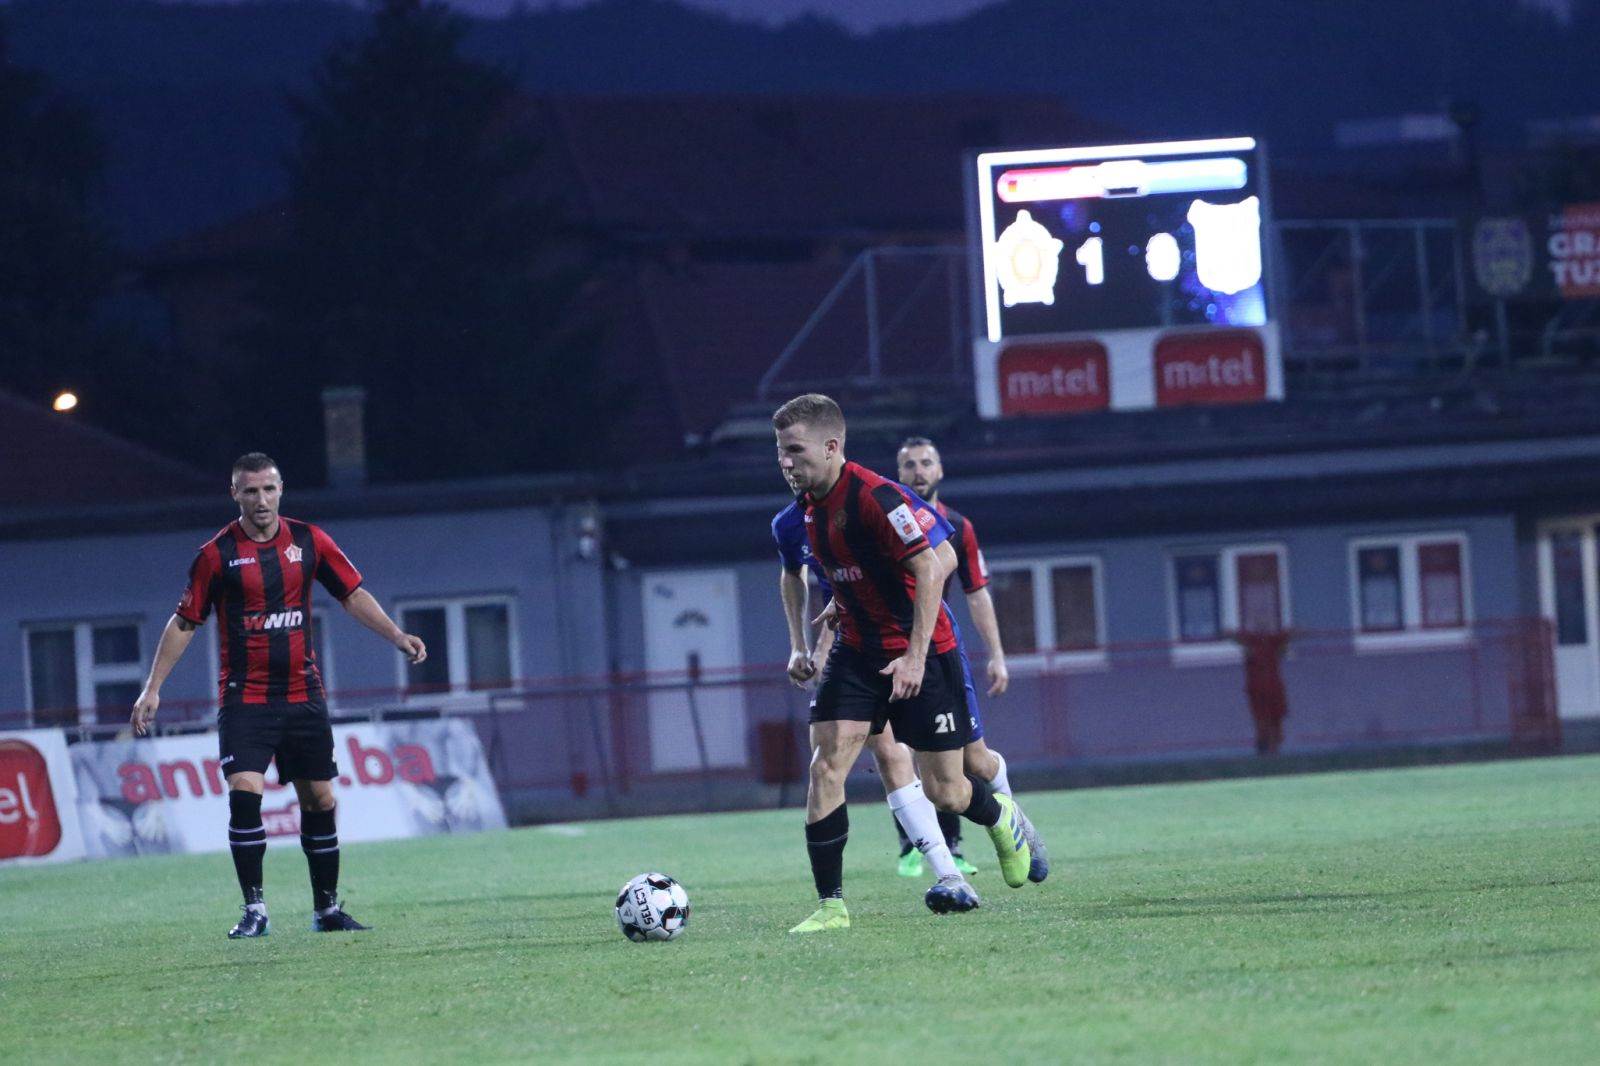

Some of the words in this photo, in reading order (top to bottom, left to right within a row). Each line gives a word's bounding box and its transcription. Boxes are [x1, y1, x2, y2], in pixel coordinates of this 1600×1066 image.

[1076, 237, 1104, 285] 1
[1146, 232, 1180, 281] 0
[935, 712, 956, 733] 21
[634, 887, 654, 925] SELECT
